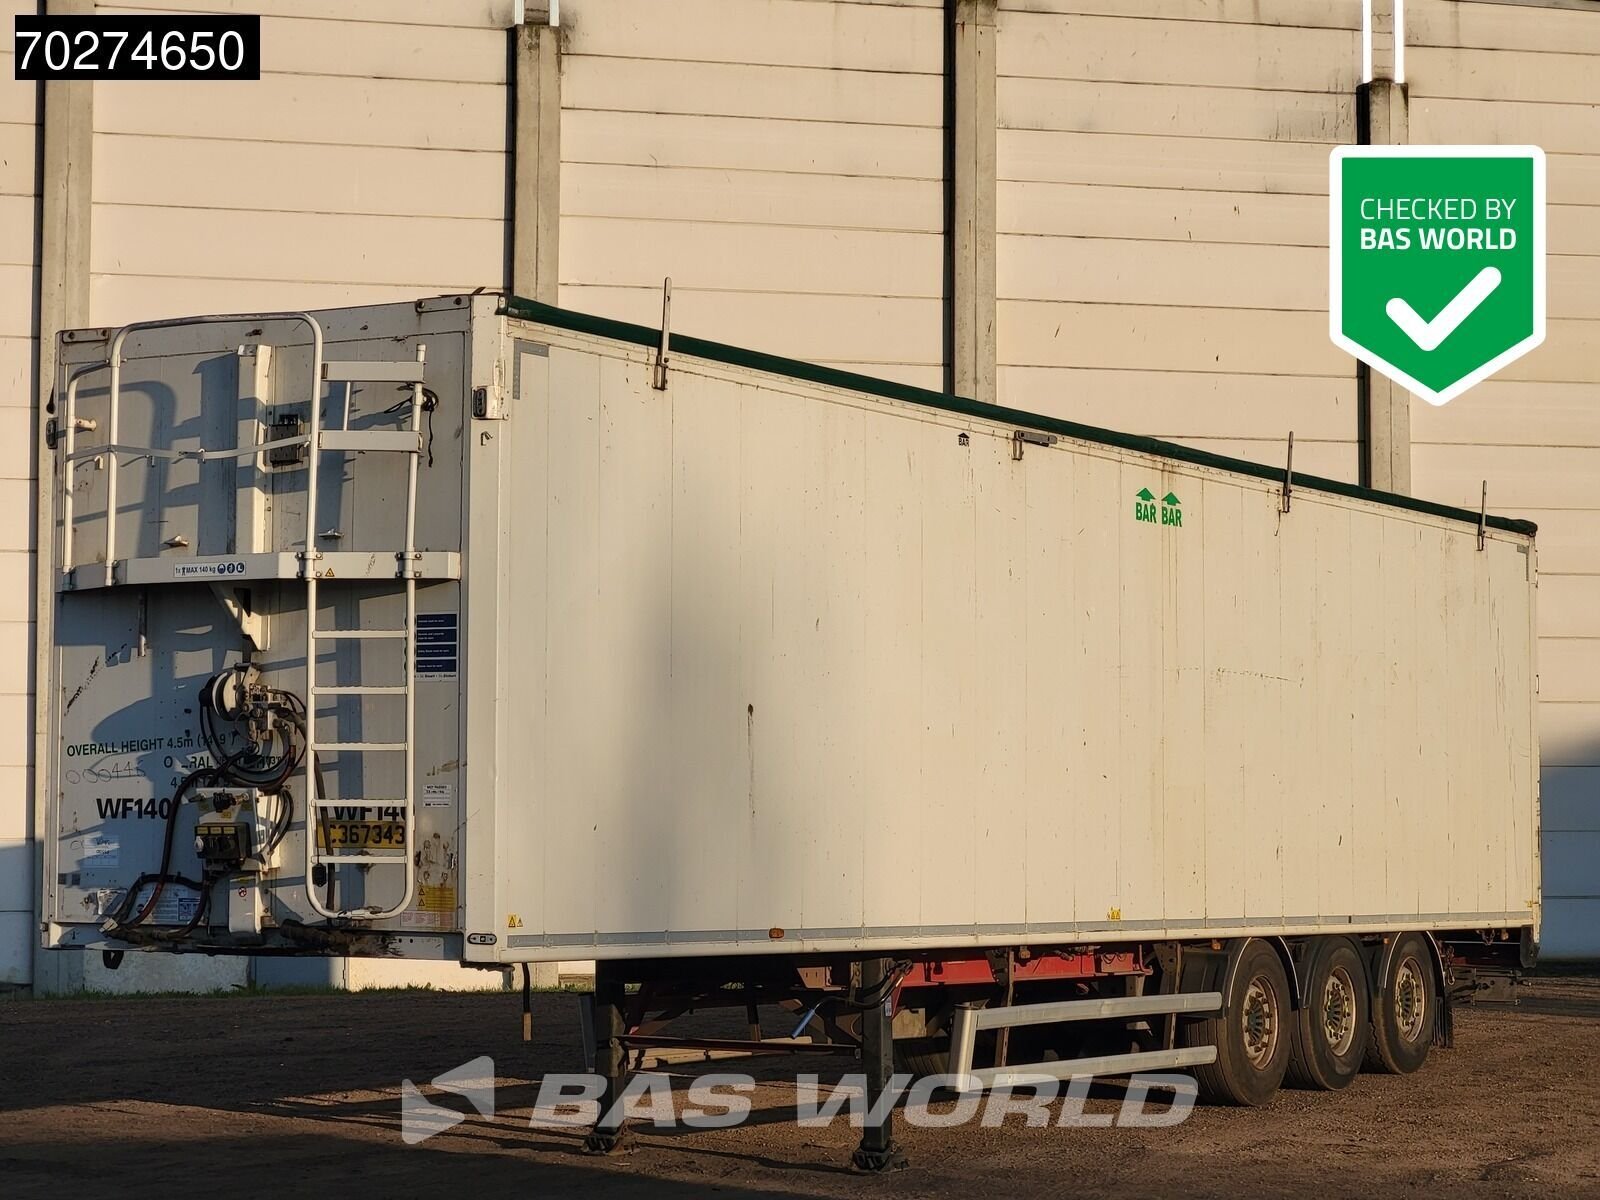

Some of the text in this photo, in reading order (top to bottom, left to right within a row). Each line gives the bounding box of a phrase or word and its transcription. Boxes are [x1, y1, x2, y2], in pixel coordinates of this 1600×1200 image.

[1135, 502, 1157, 524] BAR
[1161, 506, 1183, 528] BAR
[186, 566, 198, 574] MAX
[200, 565, 208, 573] 140
[209, 566, 216, 574] kg
[66, 742, 118, 757] OVERALL
[121, 738, 164, 753] HEIGHT
[166, 736, 193, 749] 4.5m
[96, 798, 171, 820] WF140
